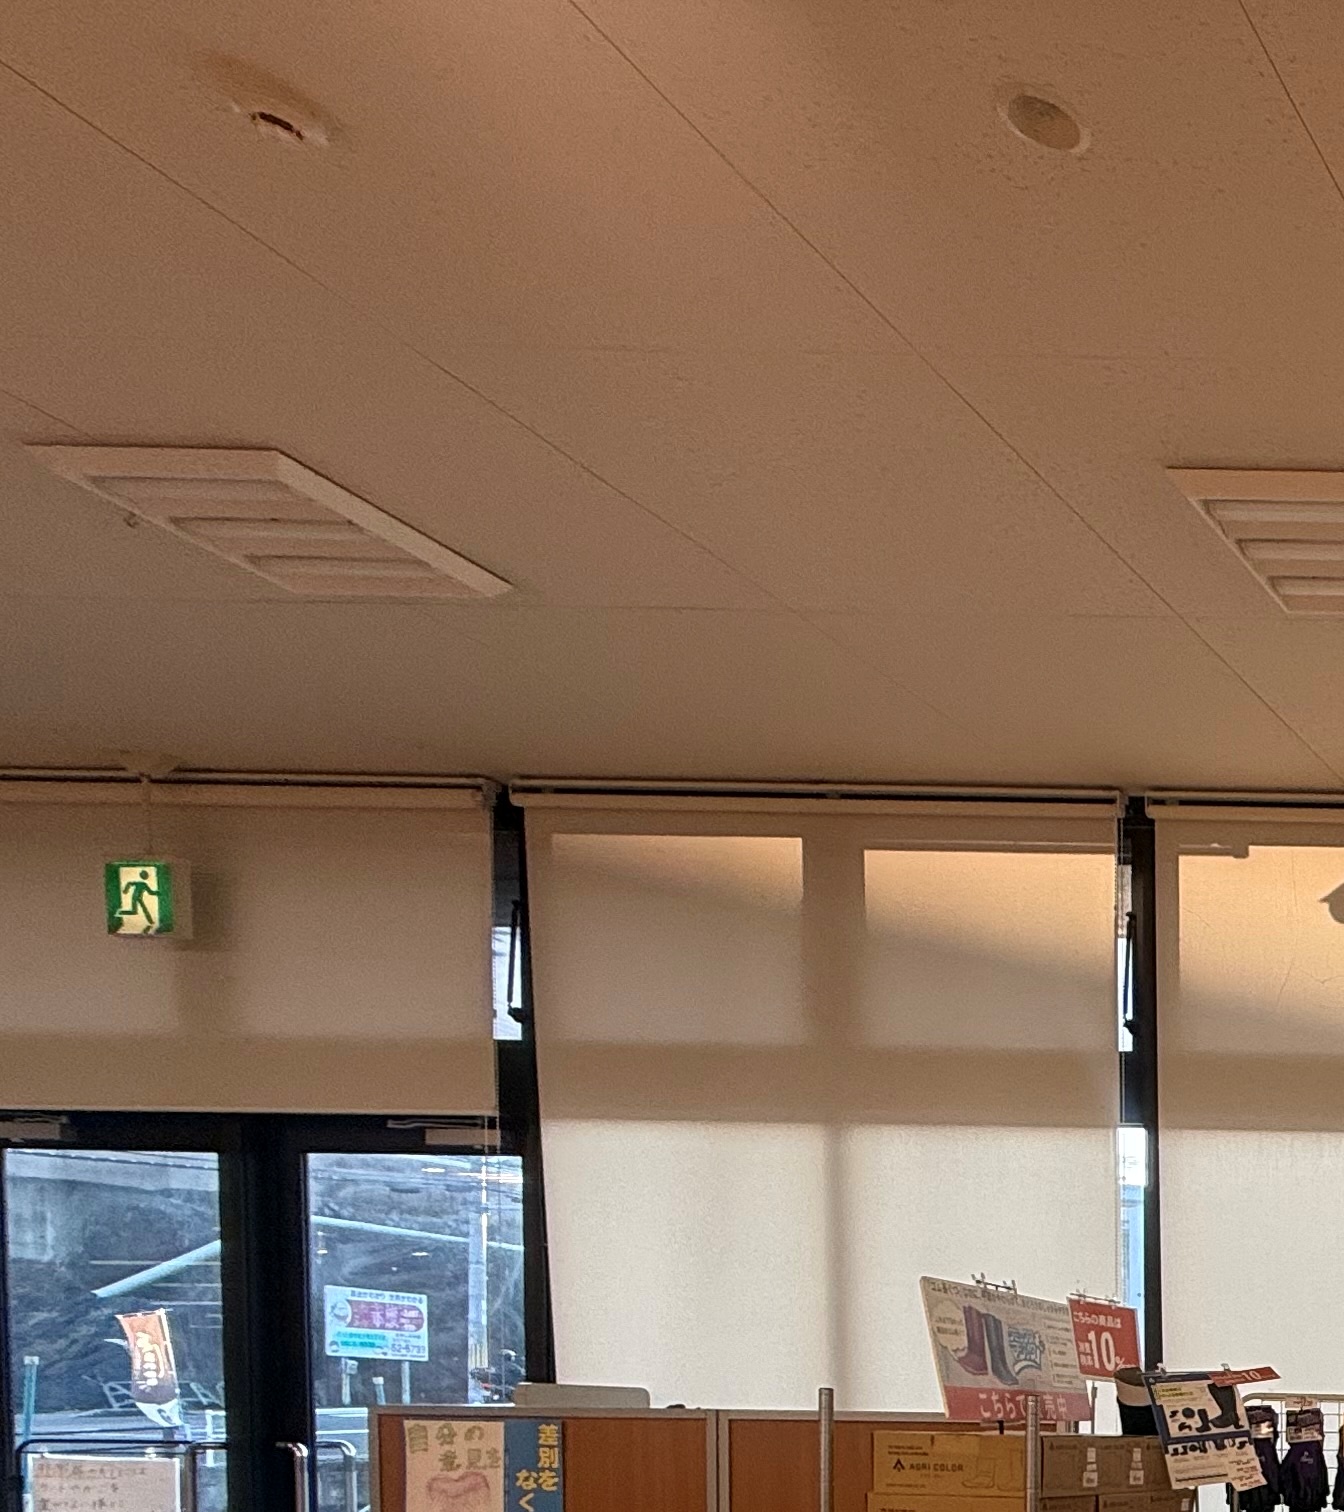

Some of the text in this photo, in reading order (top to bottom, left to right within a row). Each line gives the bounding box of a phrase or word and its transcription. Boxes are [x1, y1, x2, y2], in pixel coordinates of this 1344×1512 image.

[407, 1423, 485, 1453] 自分の
[438, 1448, 502, 1472] 意見を
[537, 1424, 560, 1492] 差別を
